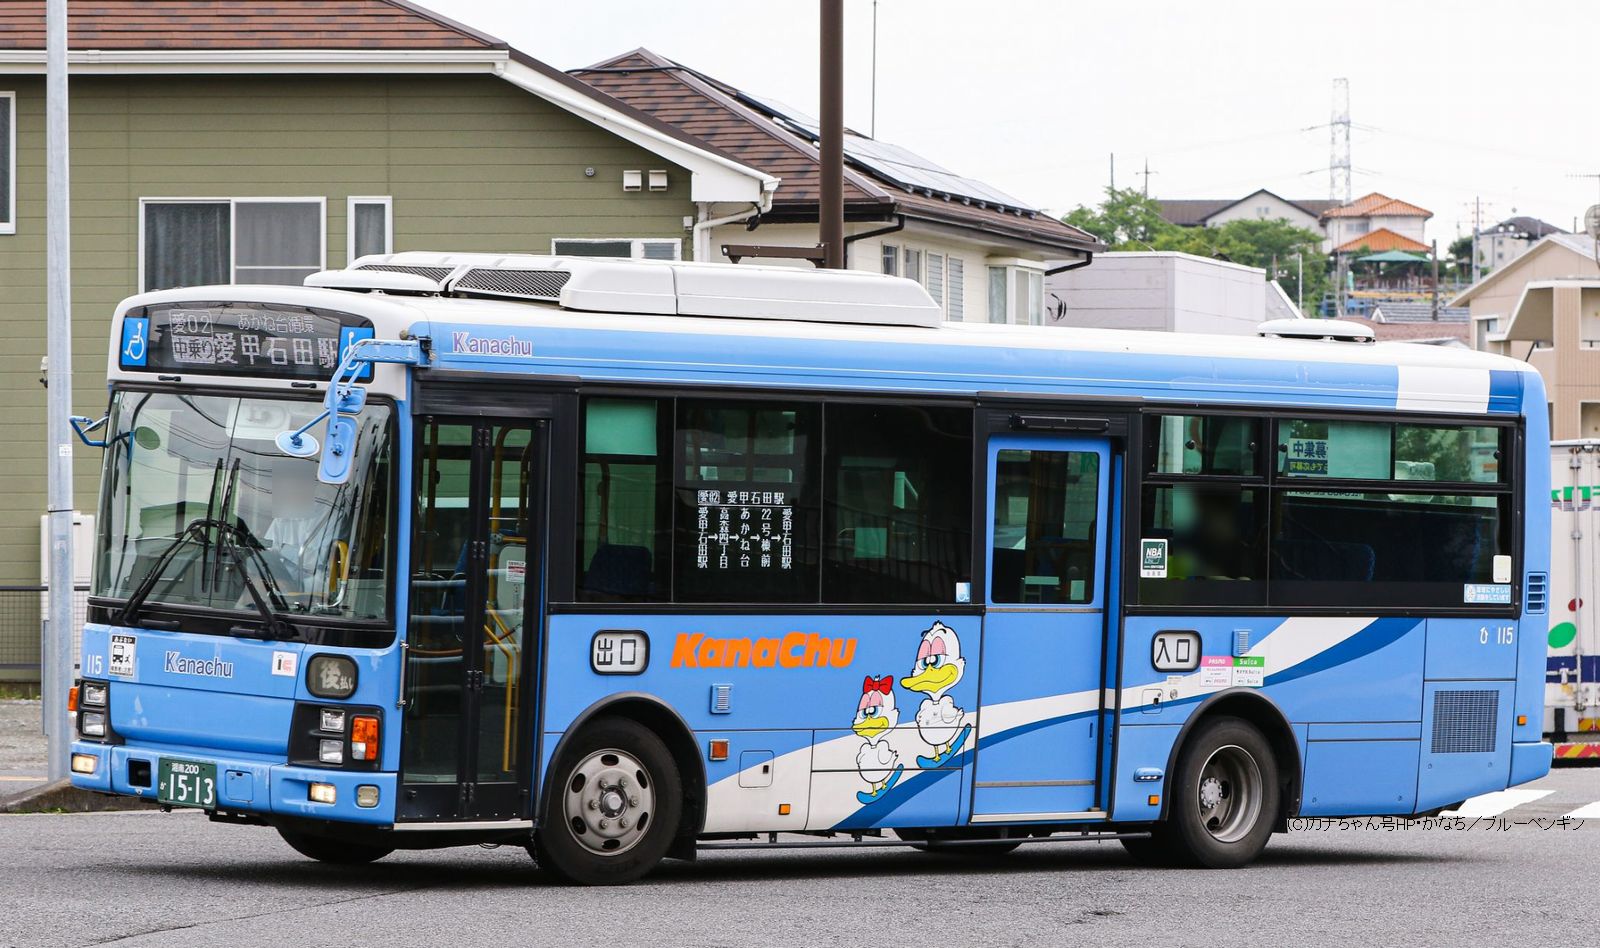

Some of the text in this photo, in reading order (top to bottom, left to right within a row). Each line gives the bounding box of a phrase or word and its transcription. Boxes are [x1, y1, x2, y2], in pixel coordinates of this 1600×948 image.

[172, 313, 211, 335] 愛02
[238, 313, 315, 334] あかね台循環
[174, 337, 213, 359] 中乗り
[214, 333, 338, 368] 愛甲石田駅
[452, 331, 532, 356] Kanachu
[727, 490, 784, 504] 愛甲石田駅
[698, 507, 708, 568] 愛甲石田駅
[719, 507, 729, 568] 高森四丁目
[740, 507, 750, 568] あかね台
[761, 508, 772, 568] 22号棟前
[782, 508, 792, 569] 愛甲石田駅
[1146, 548, 1162, 557] NBA
[1497, 627, 1513, 644] 115
[87, 654, 103, 675] 115
[597, 638, 637, 666] 出口
[670, 632, 858, 669] KanaChu
[1156, 638, 1190, 663] 入口
[165, 651, 233, 679] Kanachu
[170, 773, 213, 804] 15-13
